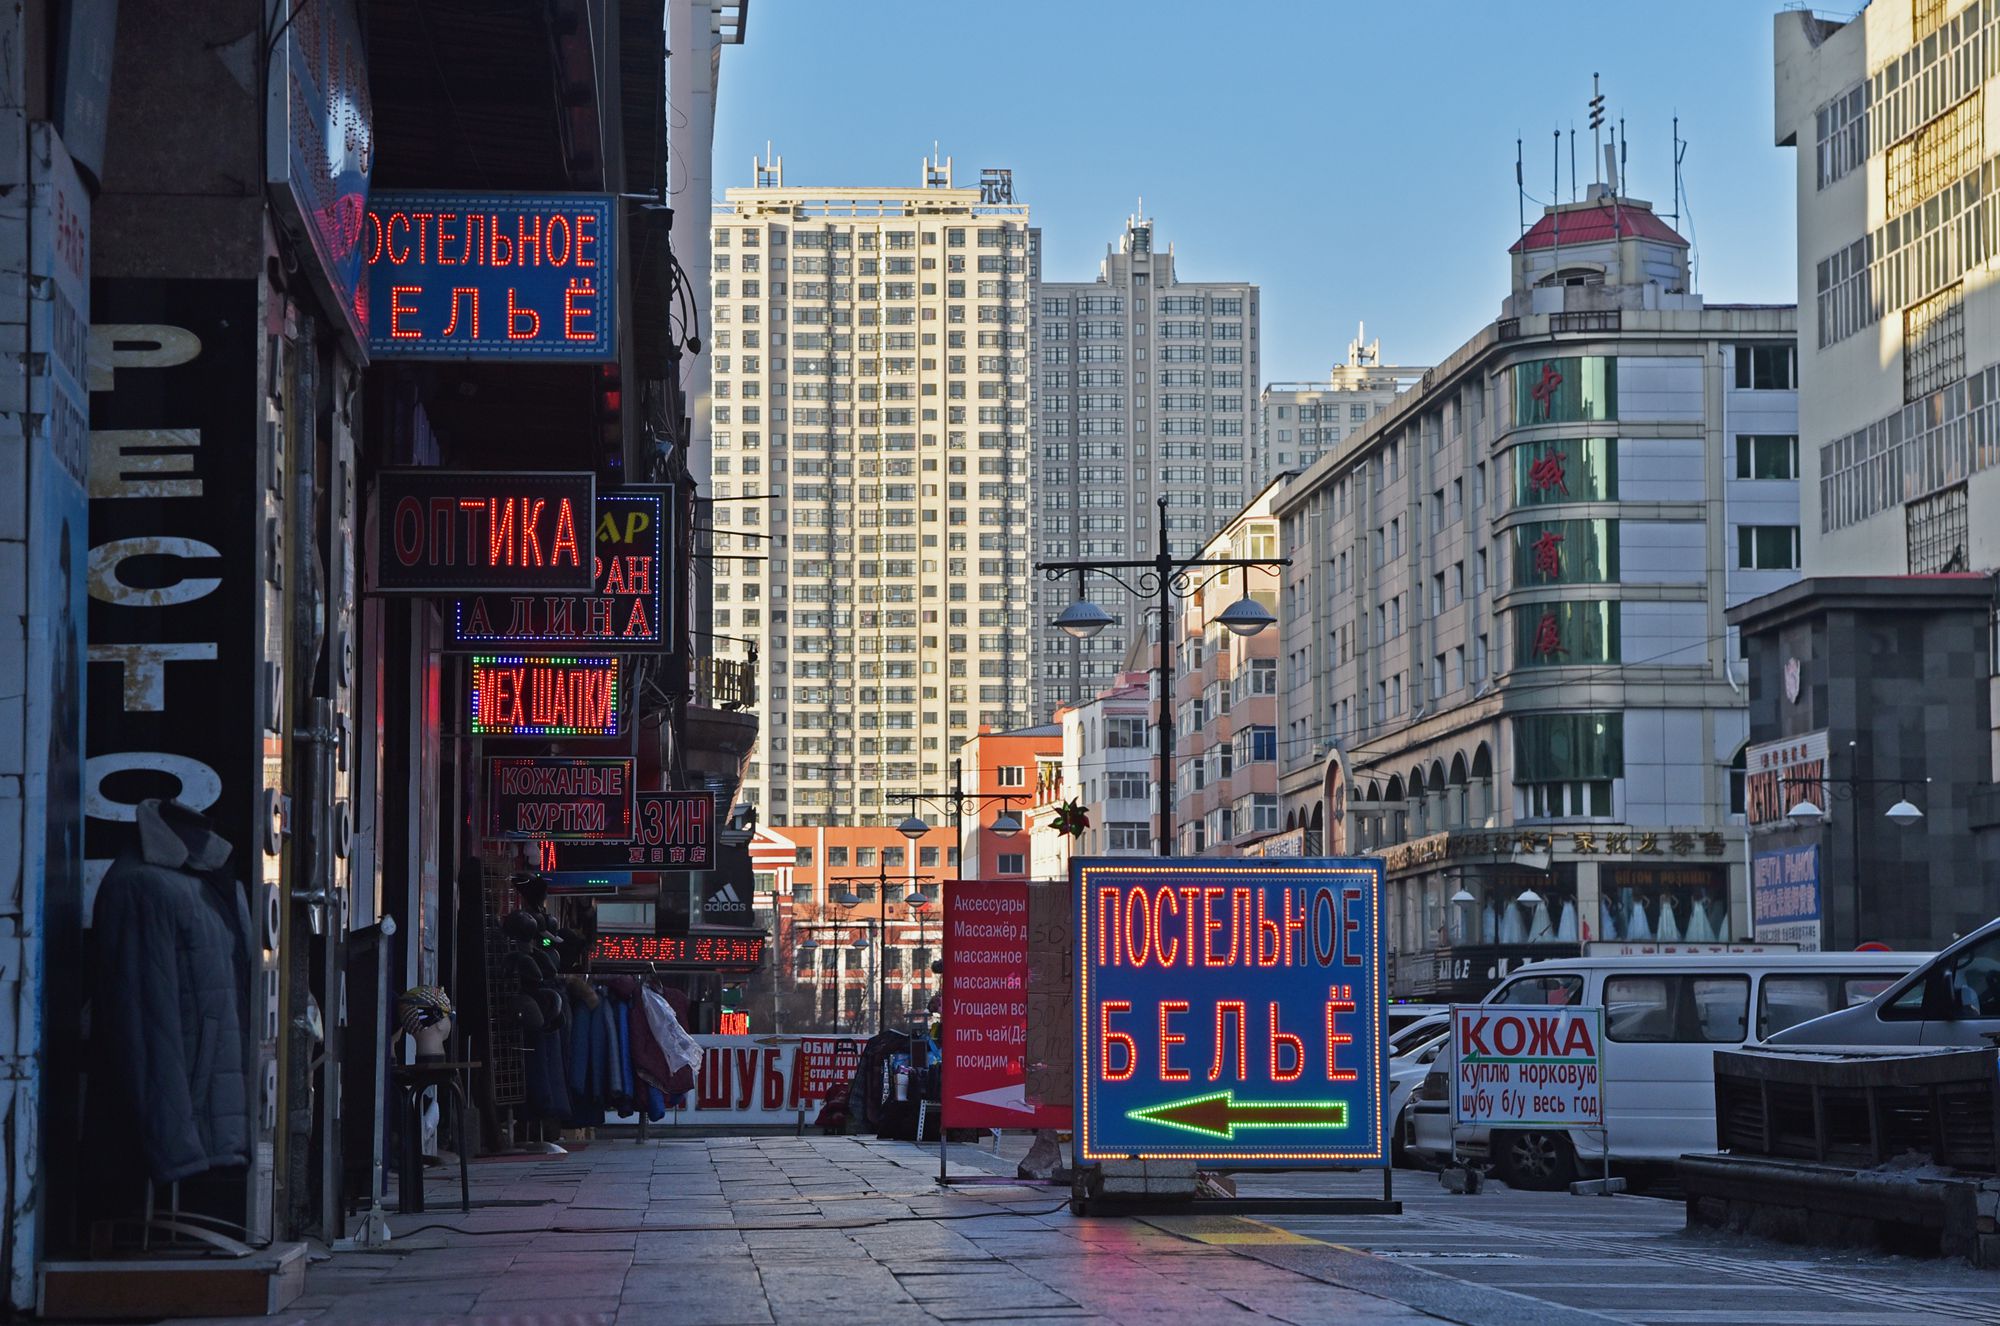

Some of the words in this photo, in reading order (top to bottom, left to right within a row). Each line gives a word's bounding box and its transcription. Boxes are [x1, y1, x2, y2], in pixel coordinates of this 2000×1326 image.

[394, 496, 580, 568] ОПТИКА
[84, 323, 223, 930] РЕСТО
[464, 597, 653, 636] АЛИНА
[478, 669, 525, 727] МЕХ
[532, 669, 612, 728] ШАПКИ
[501, 767, 622, 796] КОЖАНЫЕ
[517, 803, 606, 831] КУРТКИ
[628, 847, 707, 864] 夏日商店
[703, 900, 746, 912] adidas
[954, 895, 1025, 915] Аксессуары
[954, 921, 1017, 940] Массажёр
[1098, 885, 1363, 968] ПОСТЕЛЬНОЕ
[954, 951, 1022, 964] массажное
[953, 976, 1021, 989] массажная
[953, 999, 1008, 1018] Угощаем
[956, 1028, 983, 1042] пить
[1101, 985, 1358, 1082] БЕЛЬЁ
[1461, 1016, 1596, 1057] КОЖА
[1461, 1063, 1510, 1087] куплю
[1519, 1064, 1597, 1087] норковую
[1462, 1093, 1494, 1118] шубу
[1502, 1089, 1526, 1118] б/у
[1534, 1094, 1565, 1112] весь
[1574, 1093, 1597, 1117] год
